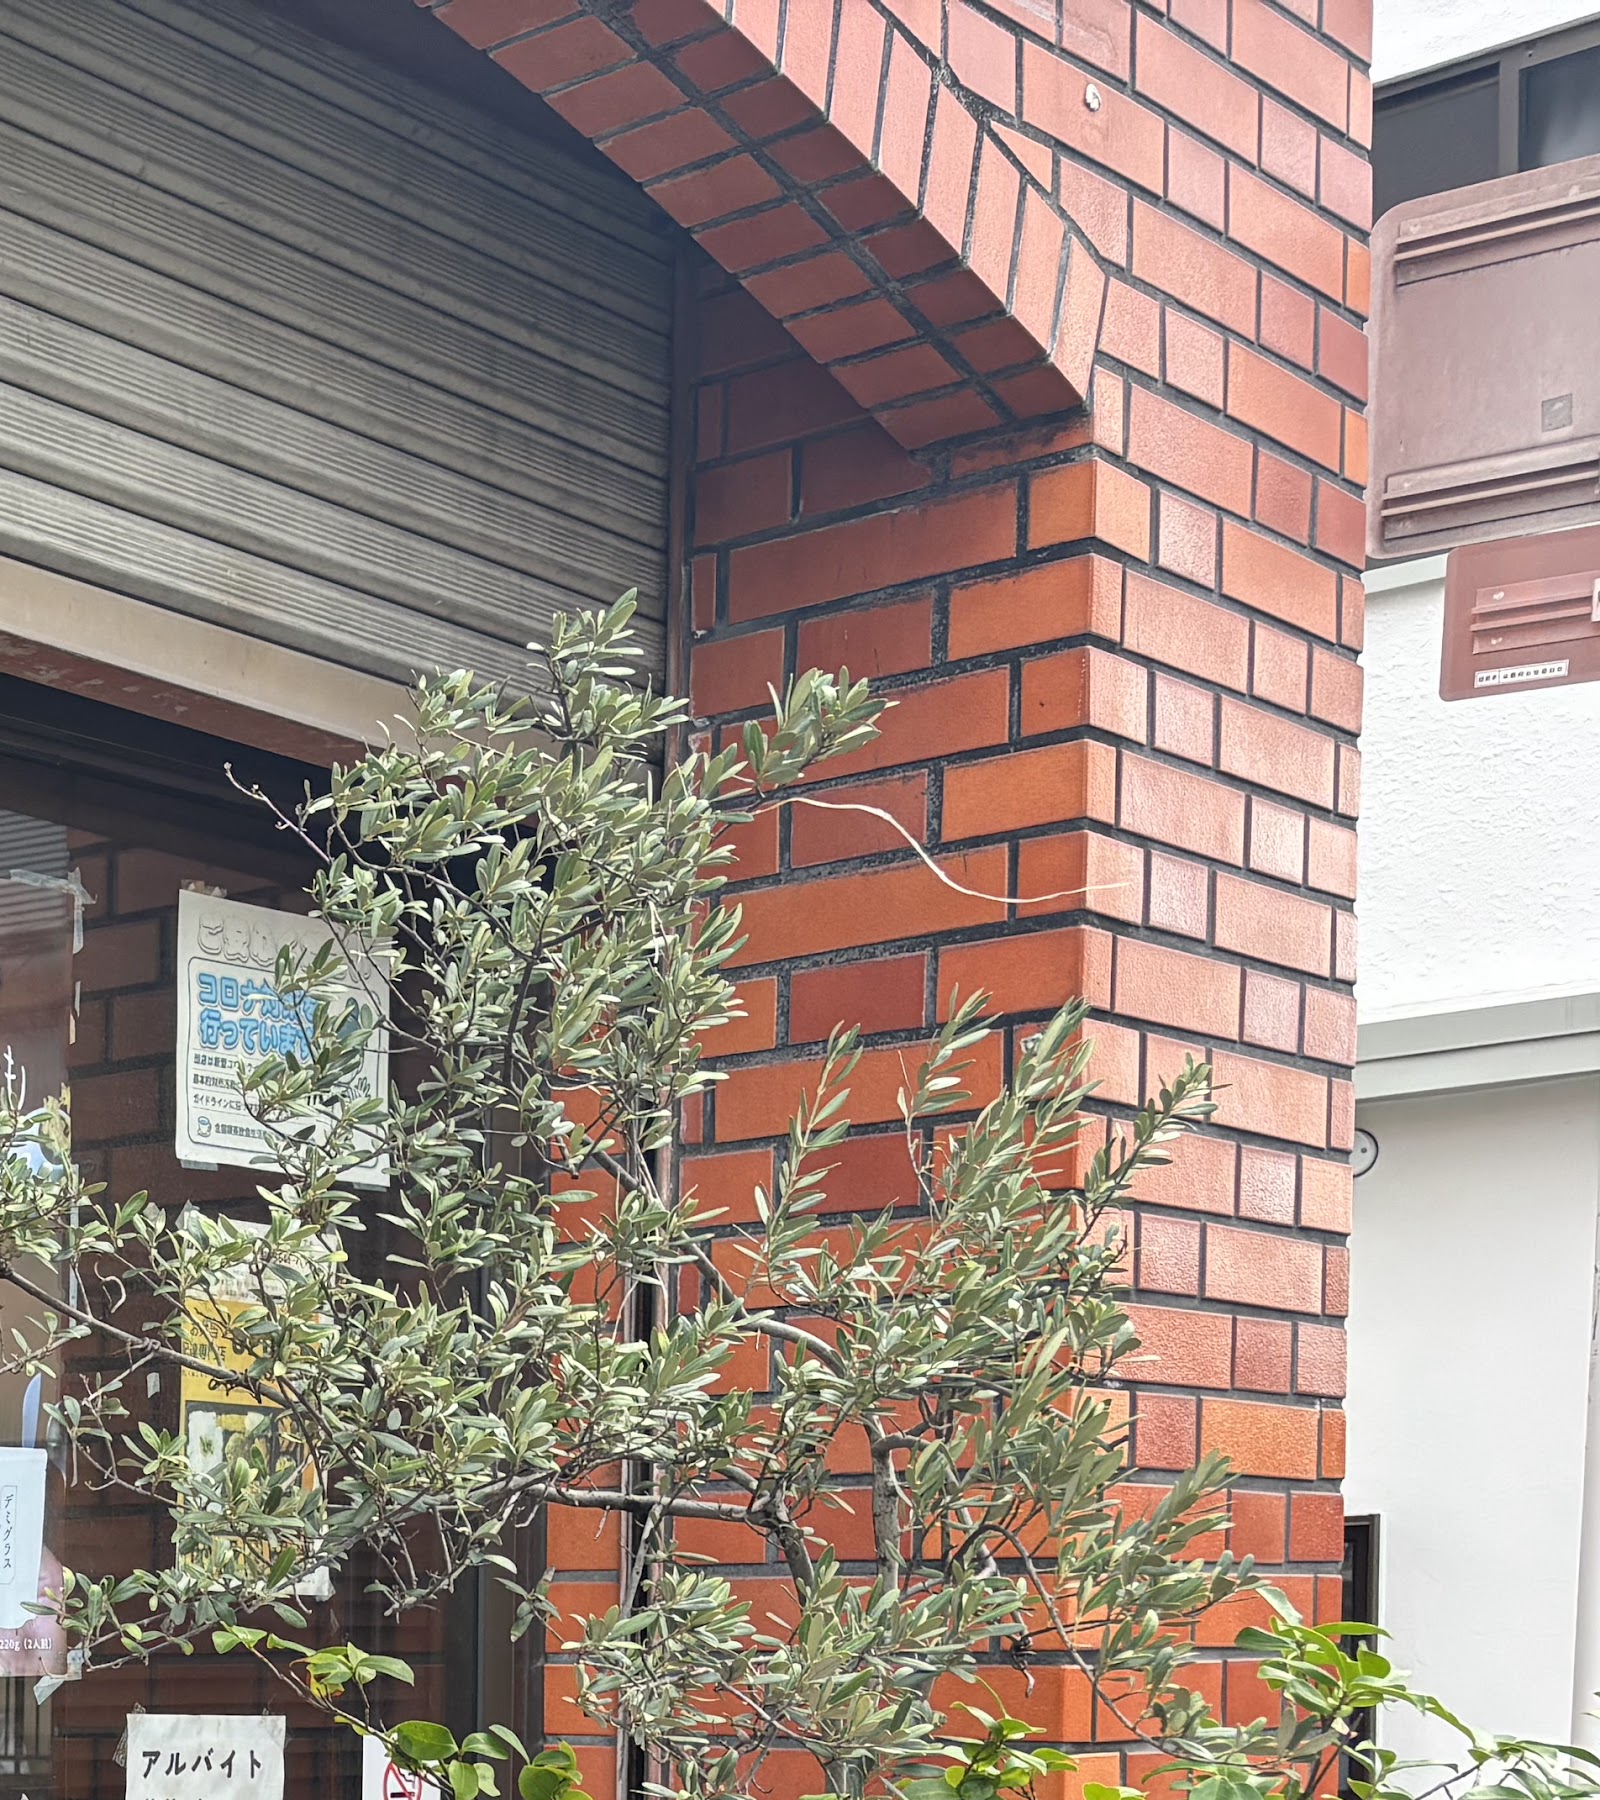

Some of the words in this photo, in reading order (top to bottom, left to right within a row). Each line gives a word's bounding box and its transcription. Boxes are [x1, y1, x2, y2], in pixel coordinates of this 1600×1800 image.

[2, 1493, 15, 1570] デミグラス
[140, 1747, 264, 1781] アルバイト
